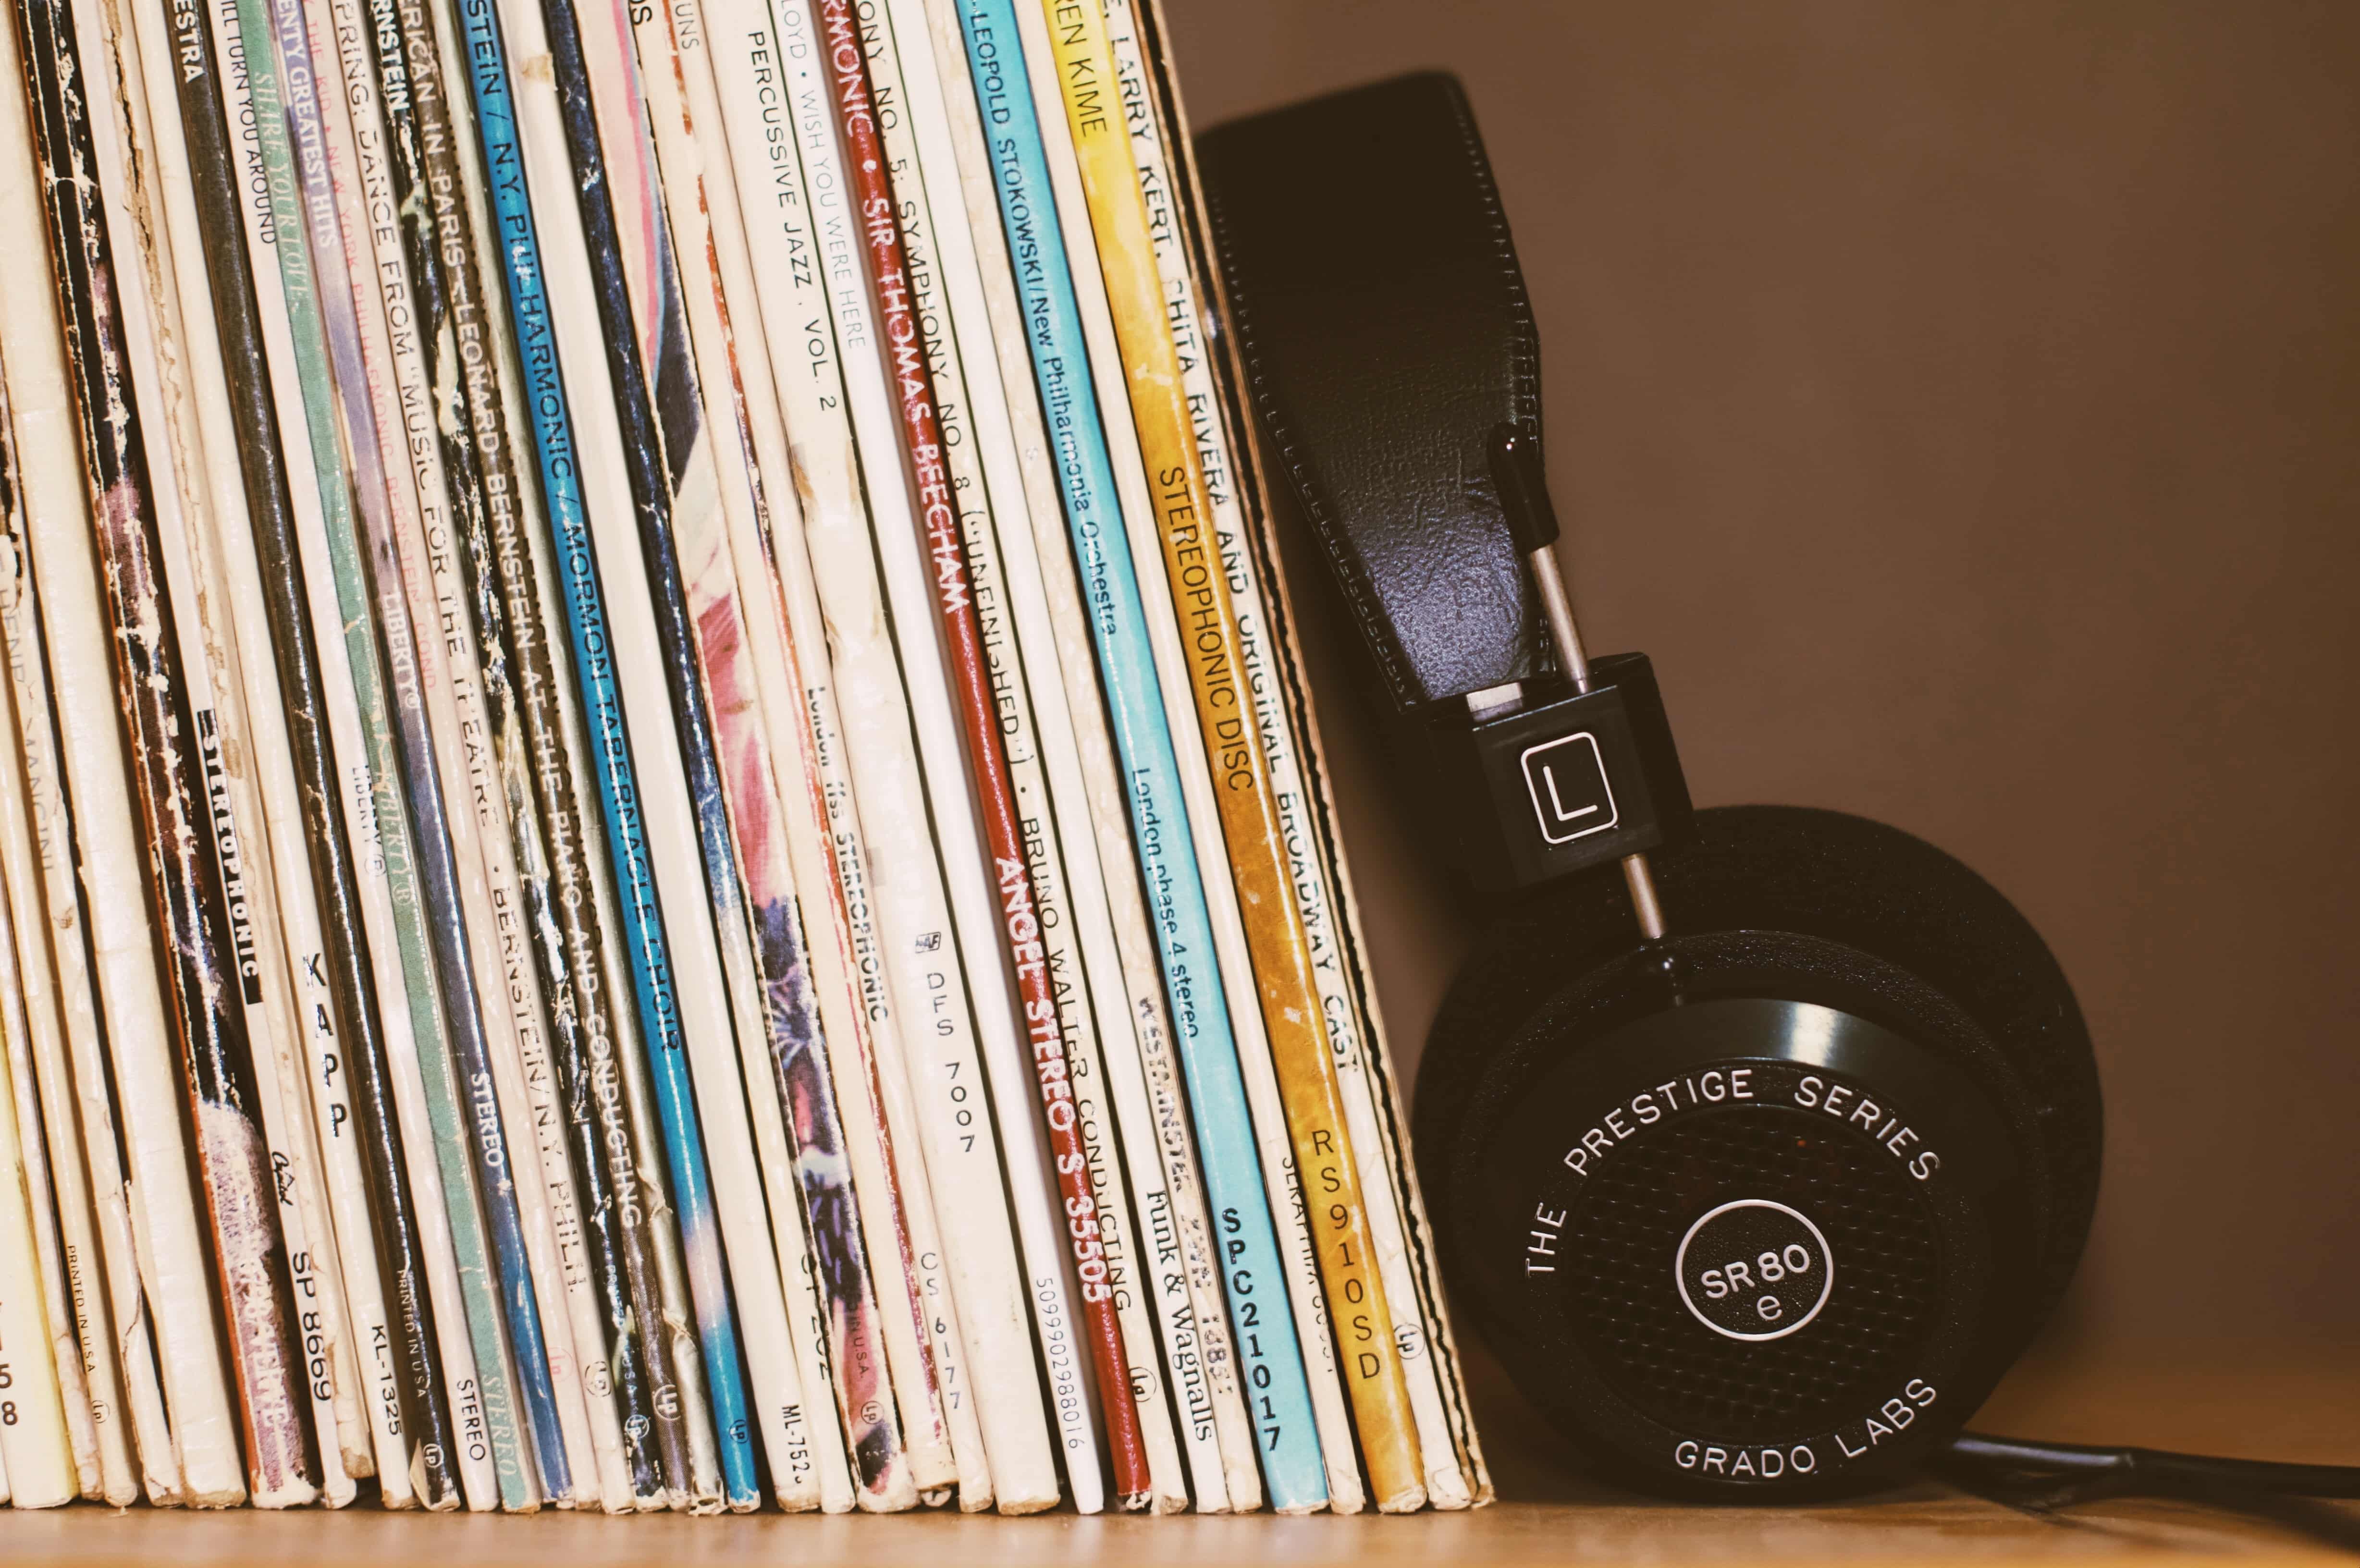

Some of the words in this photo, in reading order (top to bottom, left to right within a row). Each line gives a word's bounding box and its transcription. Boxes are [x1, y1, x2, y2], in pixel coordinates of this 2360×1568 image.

[227, 36, 250, 91] TURN
[1068, 57, 1108, 138] KIME
[237, 98, 259, 142] YOU
[253, 71, 283, 154] SHARE
[288, 65, 328, 190] GREATEST
[309, 188, 339, 249] HITS
[422, 122, 446, 156] IN
[800, 89, 826, 149] WISH
[246, 148, 278, 245] AROUND
[270, 162, 299, 230] YOUR
[492, 144, 523, 201] N.Y.
[812, 159, 838, 208] YOU
[337, 208, 360, 268] YORK
[432, 175, 466, 267] PARIS
[748, 31, 798, 208] PERCUSSIVE
[784, 222, 813, 289] JAZZ
[804, 319, 828, 384] VOL.
[819, 396, 837, 411] 2
[826, 216, 852, 282] WERE
[279, 233, 309, 303] LOVE
[505, 213, 573, 480] PHILHARMONIC
[839, 288, 866, 350] HERE
[970, 12, 1011, 125] LEOPOLD
[1042, 356, 1091, 513] Philharmonia
[1079, 519, 1118, 636] Orchestra
[359, 129, 395, 245] DANCE
[382, 260, 414, 357] FROM
[425, 507, 451, 575] FOR
[439, 594, 467, 658] THE
[454, 303, 501, 454] LEONARD
[864, 197, 894, 247] SIR
[879, 268, 931, 422] THOMAS
[914, 444, 971, 614] BEECHAM
[486, 473, 536, 649] BERNSTEIN
[1111, 36, 1153, 141] LARRY
[1187, 393, 1229, 507] RIVERA
[1216, 529, 1250, 596] AND
[1237, 612, 1286, 773] ORIGINAL
[1276, 792, 1336, 971] BROADWAY
[1324, 994, 1359, 1073] CAST
[383, 591, 416, 694] LIBERTY
[563, 524, 610, 681] MORMON
[1158, 466, 1236, 709] STEREOPHONIC
[1215, 718, 1254, 792] DISC
[522, 669, 551, 709] AT
[874, 86, 898, 141] NO.
[896, 200, 948, 380] SYMPHONY
[938, 403, 961, 456] NO.
[953, 476, 970, 491] 8
[1020, 817, 1059, 930] BRUNO
[1049, 948, 1088, 1079] WALTER
[1078, 1099, 1132, 1313] CONDUCTING
[534, 731, 563, 793] THE
[1543, 765, 1598, 821] L
[203, 734, 259, 979] STEREOPHONIC
[597, 702, 659, 925] TABERNACLE
[808, 686, 836, 768] London
[836, 831, 888, 1024] STEREOPHONIC
[1131, 767, 1163, 858] London
[548, 811, 583, 909] PIANO
[1145, 864, 1178, 934] phase
[569, 927, 601, 995] AND
[996, 857, 1045, 980] ANGEL
[1163, 941, 1189, 958] 4
[642, 939, 680, 1053] CHOIR
[1170, 963, 1199, 1039] stereo
[945, 1061, 975, 1153] 7007
[1026, 999, 1077, 1133] STEREO
[470, 1072, 505, 1169] STEREO
[583, 1013, 642, 1228] CONDUCTING
[1057, 1152, 1086, 1176] S
[1524, 1201, 1567, 1281] THE
[1564, 1068, 1755, 1178] PRESTIGE
[1794, 1076, 1942, 1181] SERIES
[1065, 1194, 1113, 1304] 35505
[1146, 1189, 1180, 1266] Funk
[68, 1245, 85, 1308] PRINTED
[78, 1314, 88, 1330] IN
[292, 1251, 316, 1298] SP
[1164, 1272, 1186, 1297] &
[1756, 1294, 1784, 1321] e
[303, 1311, 332, 1402] 8669
[370, 1324, 403, 1436] KL-1325
[408, 1338, 420, 1357] IN
[1035, 1277, 1086, 1451] 5099902988016
[1169, 1304, 1213, 1443] Wagnalls
[456, 1379, 486, 1462] STEREO
[482, 1374, 519, 1477] STEREO
[1674, 1440, 1816, 1479] GRADO
[1834, 1378, 1937, 1458] LABS
